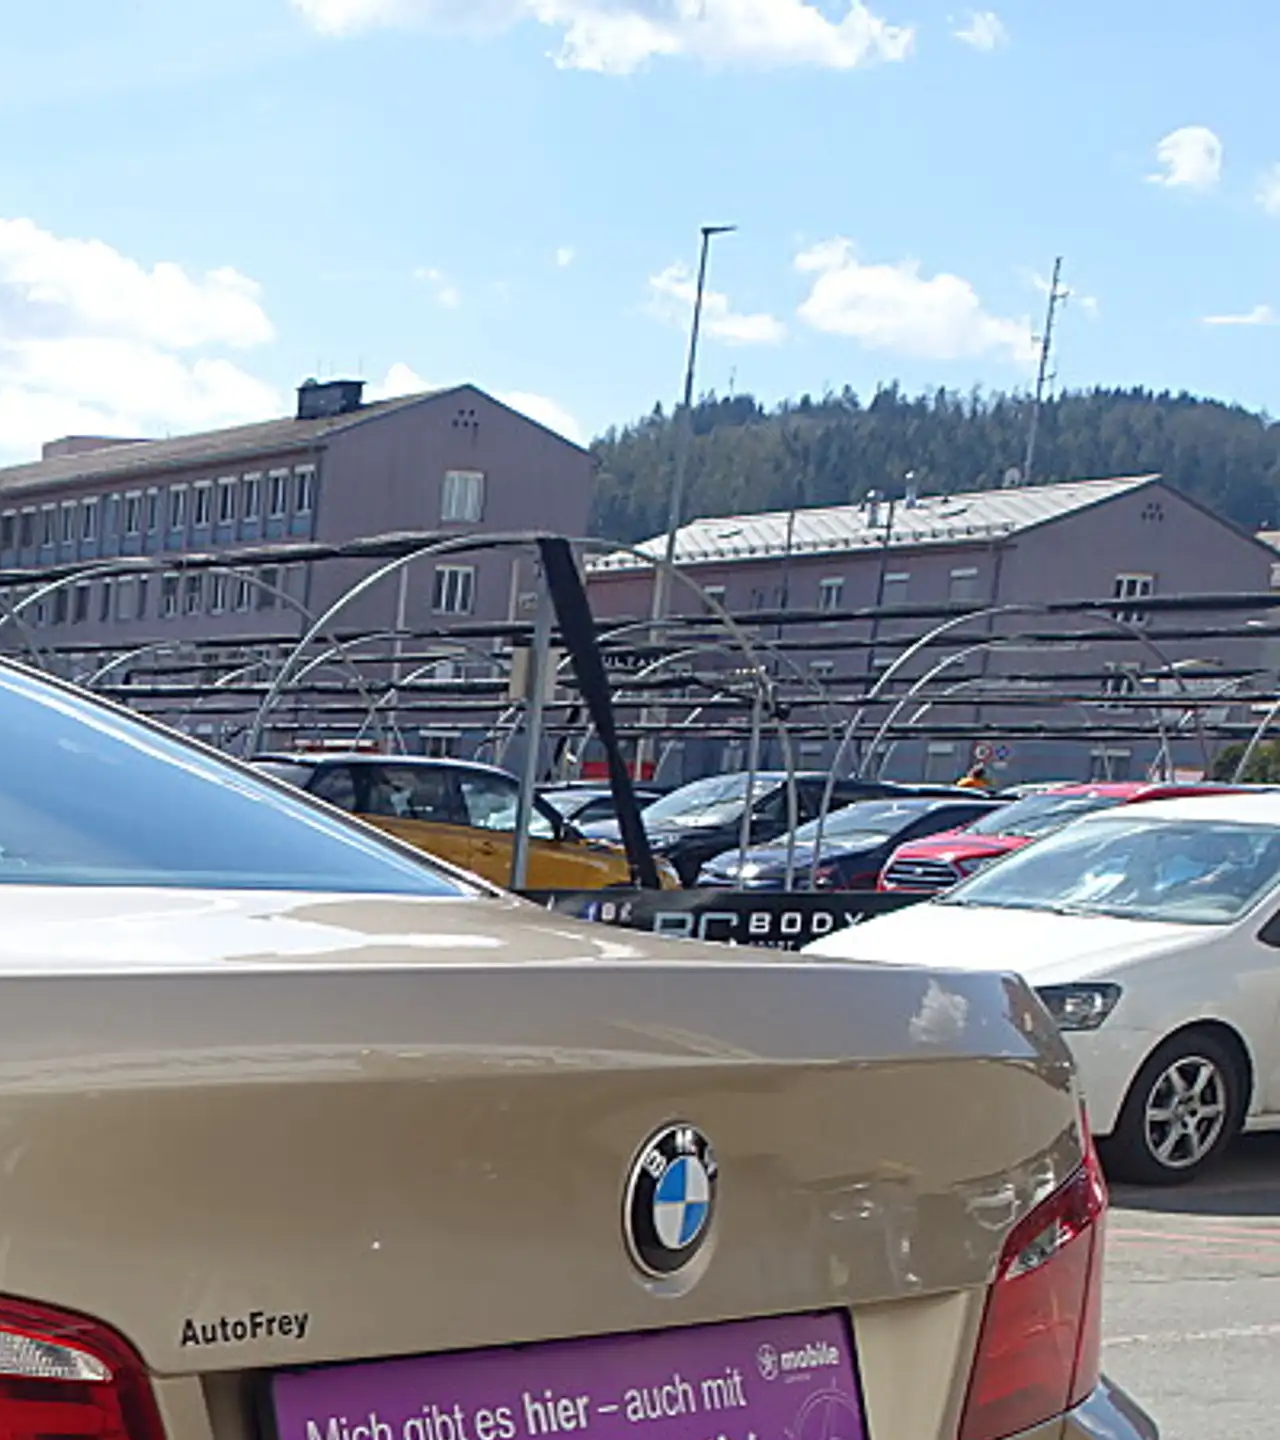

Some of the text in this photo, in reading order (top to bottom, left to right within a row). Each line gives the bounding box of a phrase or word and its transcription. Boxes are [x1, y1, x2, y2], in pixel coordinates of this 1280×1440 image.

[748, 911, 865, 934] BODY
[180, 1309, 310, 1347] AutoFrey
[780, 1341, 840, 1371] mobile
[522, 1390, 590, 1435] hier
[624, 1373, 697, 1422] auch
[701, 1367, 747, 1410] mit
